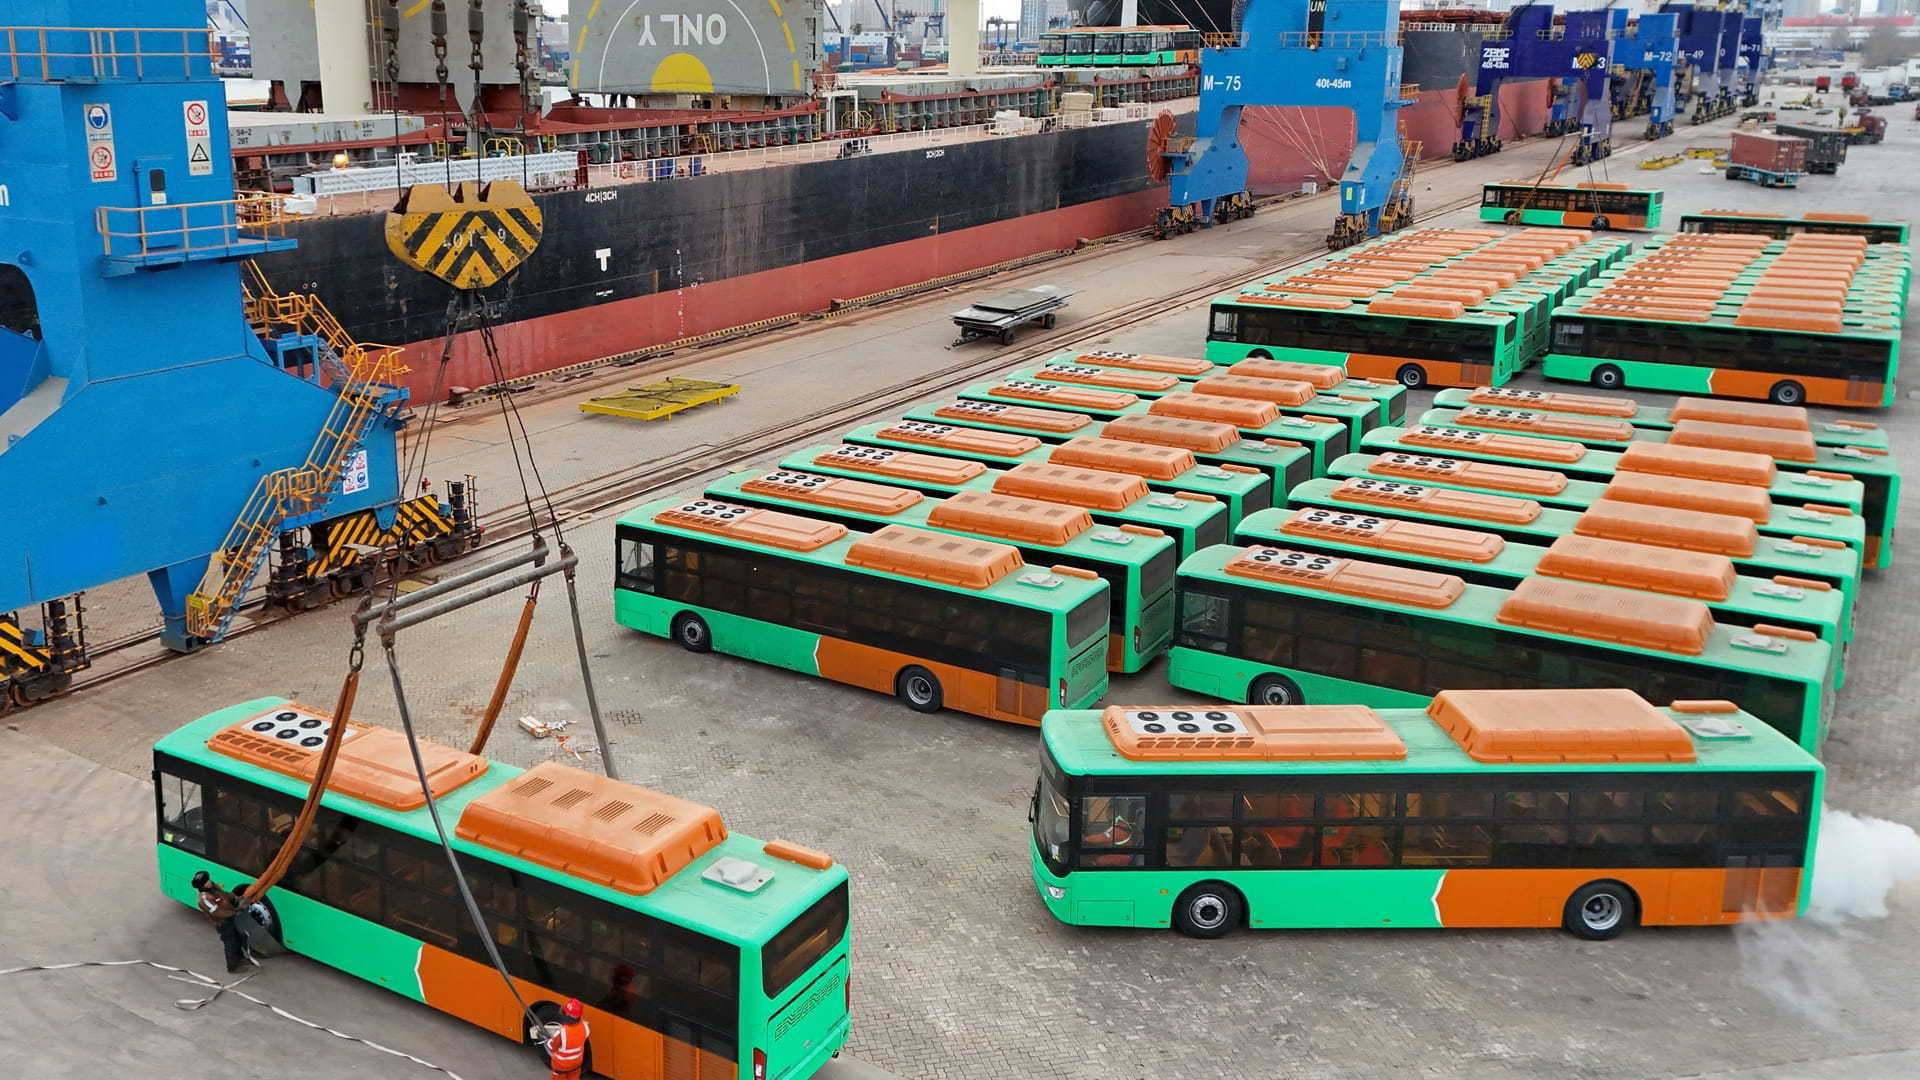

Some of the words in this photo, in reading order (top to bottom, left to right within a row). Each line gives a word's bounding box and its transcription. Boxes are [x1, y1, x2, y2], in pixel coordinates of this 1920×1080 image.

[638, 13, 727, 46] ONLY
[1643, 51, 1673, 62] M-72
[1203, 75, 1242, 91] M-75
[1315, 78, 1351, 89] 40t-45m
[595, 248, 611, 271] T
